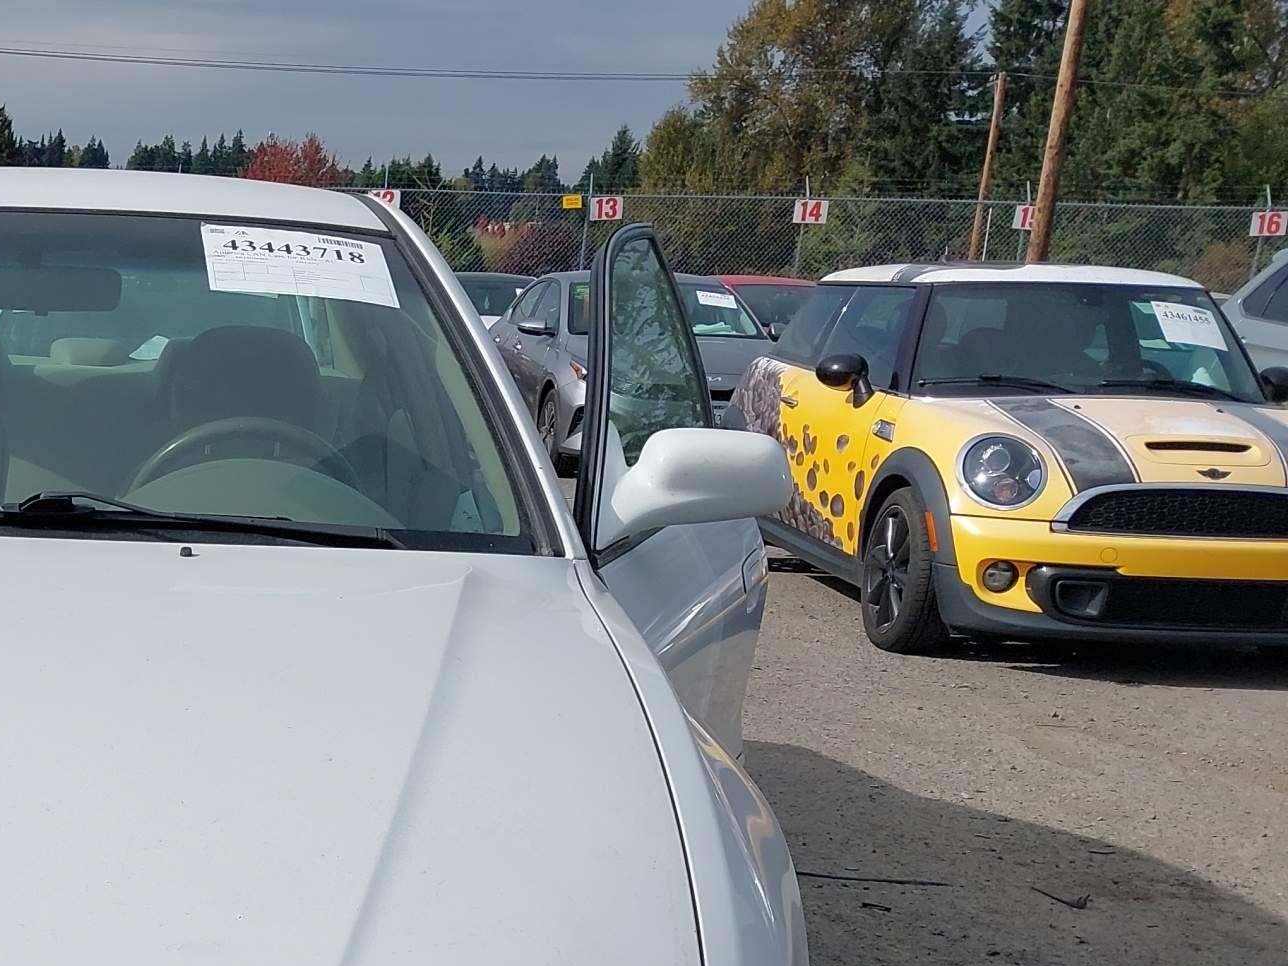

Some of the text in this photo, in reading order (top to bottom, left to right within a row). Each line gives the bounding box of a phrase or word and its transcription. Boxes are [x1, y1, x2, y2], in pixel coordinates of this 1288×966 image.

[597, 198, 619, 220] 13
[800, 201, 823, 222] 14
[1258, 213, 1282, 235] 16
[223, 239, 366, 264] 43443718
